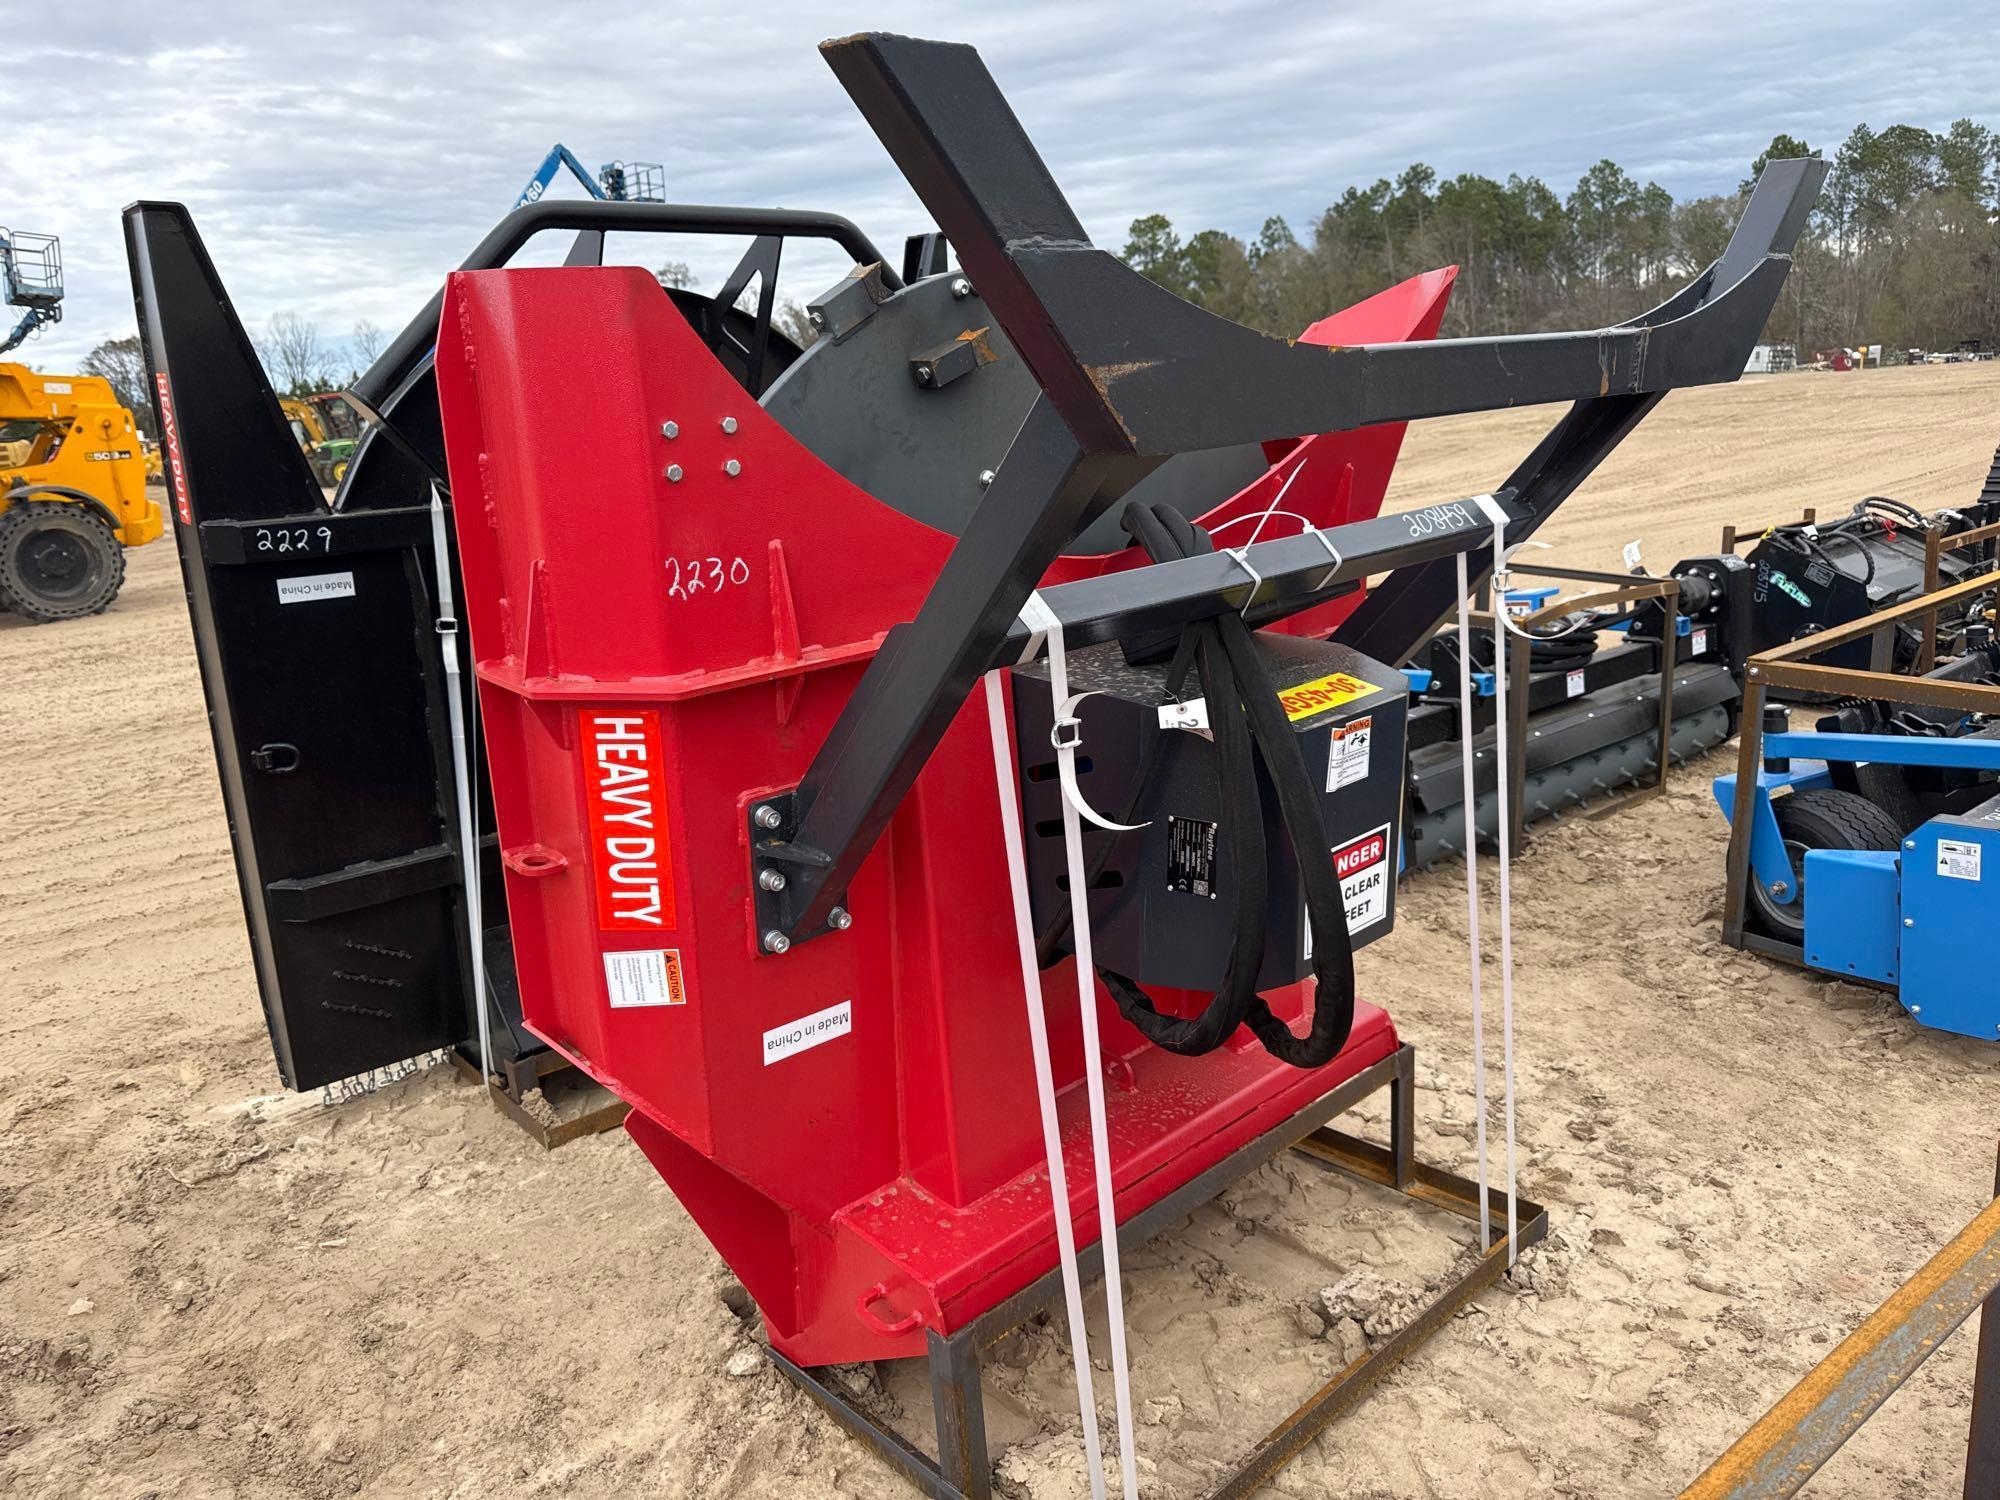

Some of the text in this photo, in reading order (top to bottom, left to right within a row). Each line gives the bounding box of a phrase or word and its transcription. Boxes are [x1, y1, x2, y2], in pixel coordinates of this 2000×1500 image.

[158, 378, 191, 523] HEAVY DUTY
[1402, 502, 1478, 538] 208459
[256, 526, 332, 553] 2229
[281, 580, 353, 595] Made in China
[667, 555, 751, 598] 2230
[1346, 719, 1371, 734] RNING
[593, 717, 663, 926] HEAVY DUTY
[1207, 826, 1217, 861] Raytree
[1338, 841, 1381, 874] NGER
[1344, 873, 1381, 901] CLEAR
[667, 964, 681, 1000] CAUTION
[767, 1011, 850, 1050] Made in China
